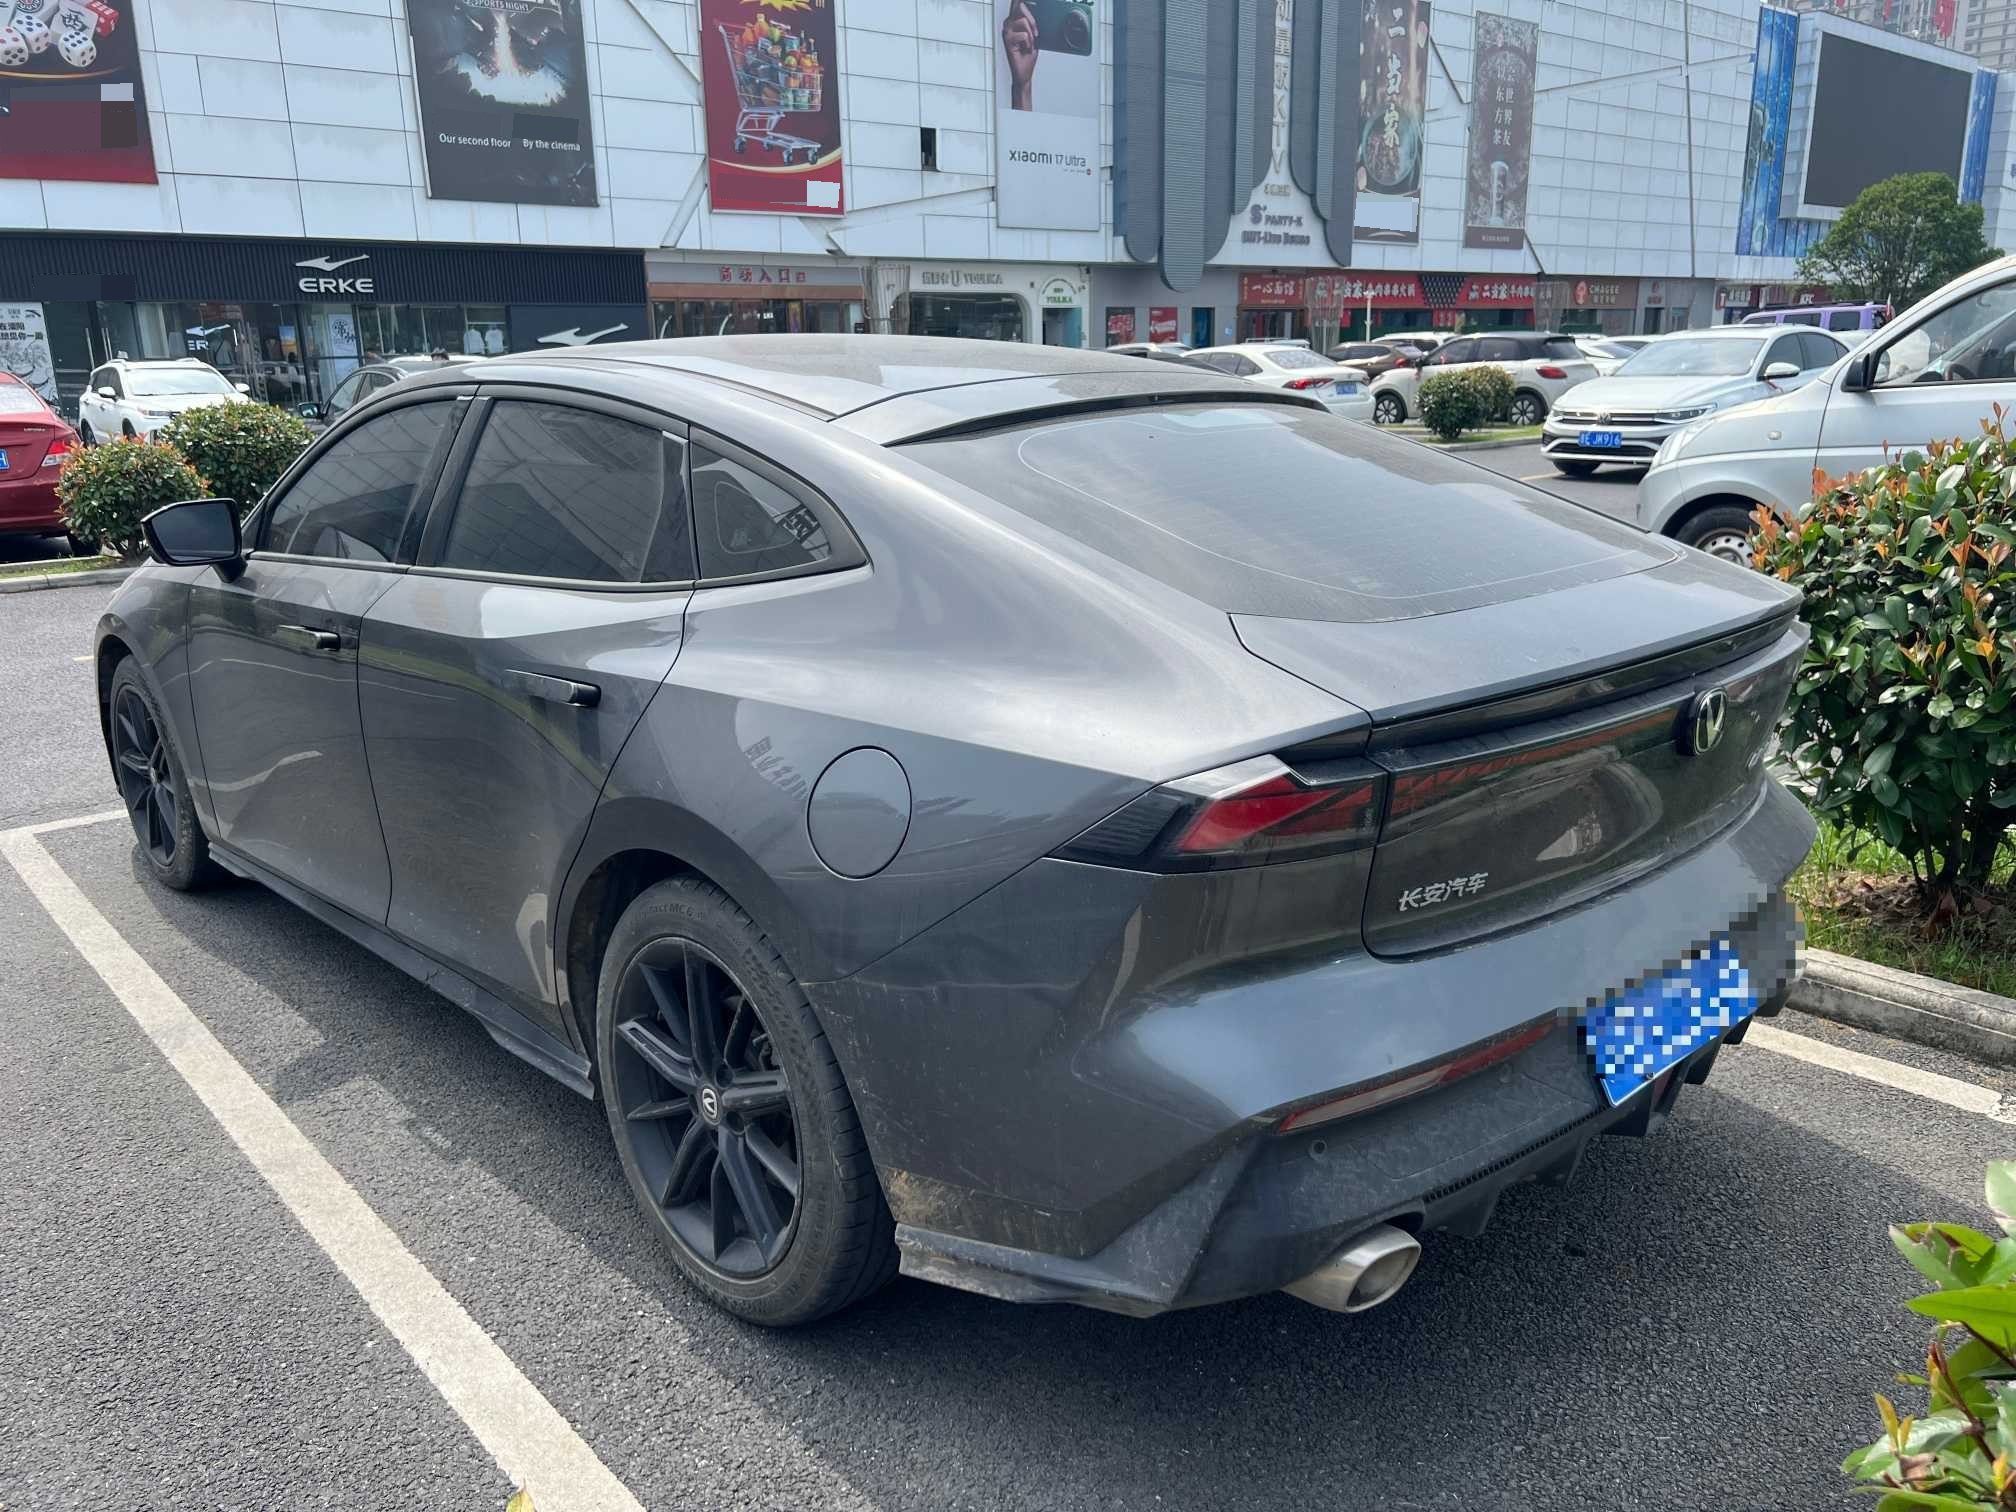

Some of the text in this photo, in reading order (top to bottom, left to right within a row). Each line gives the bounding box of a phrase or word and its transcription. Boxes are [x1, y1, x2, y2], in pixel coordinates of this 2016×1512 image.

[439, 133, 581, 151] Our second floor By the cinema
[1055, 154, 1064, 164] 17
[1065, 155, 1087, 167] Ultra
[299, 277, 374, 294] ERKE
[1398, 872, 1489, 911] 长安汽车
